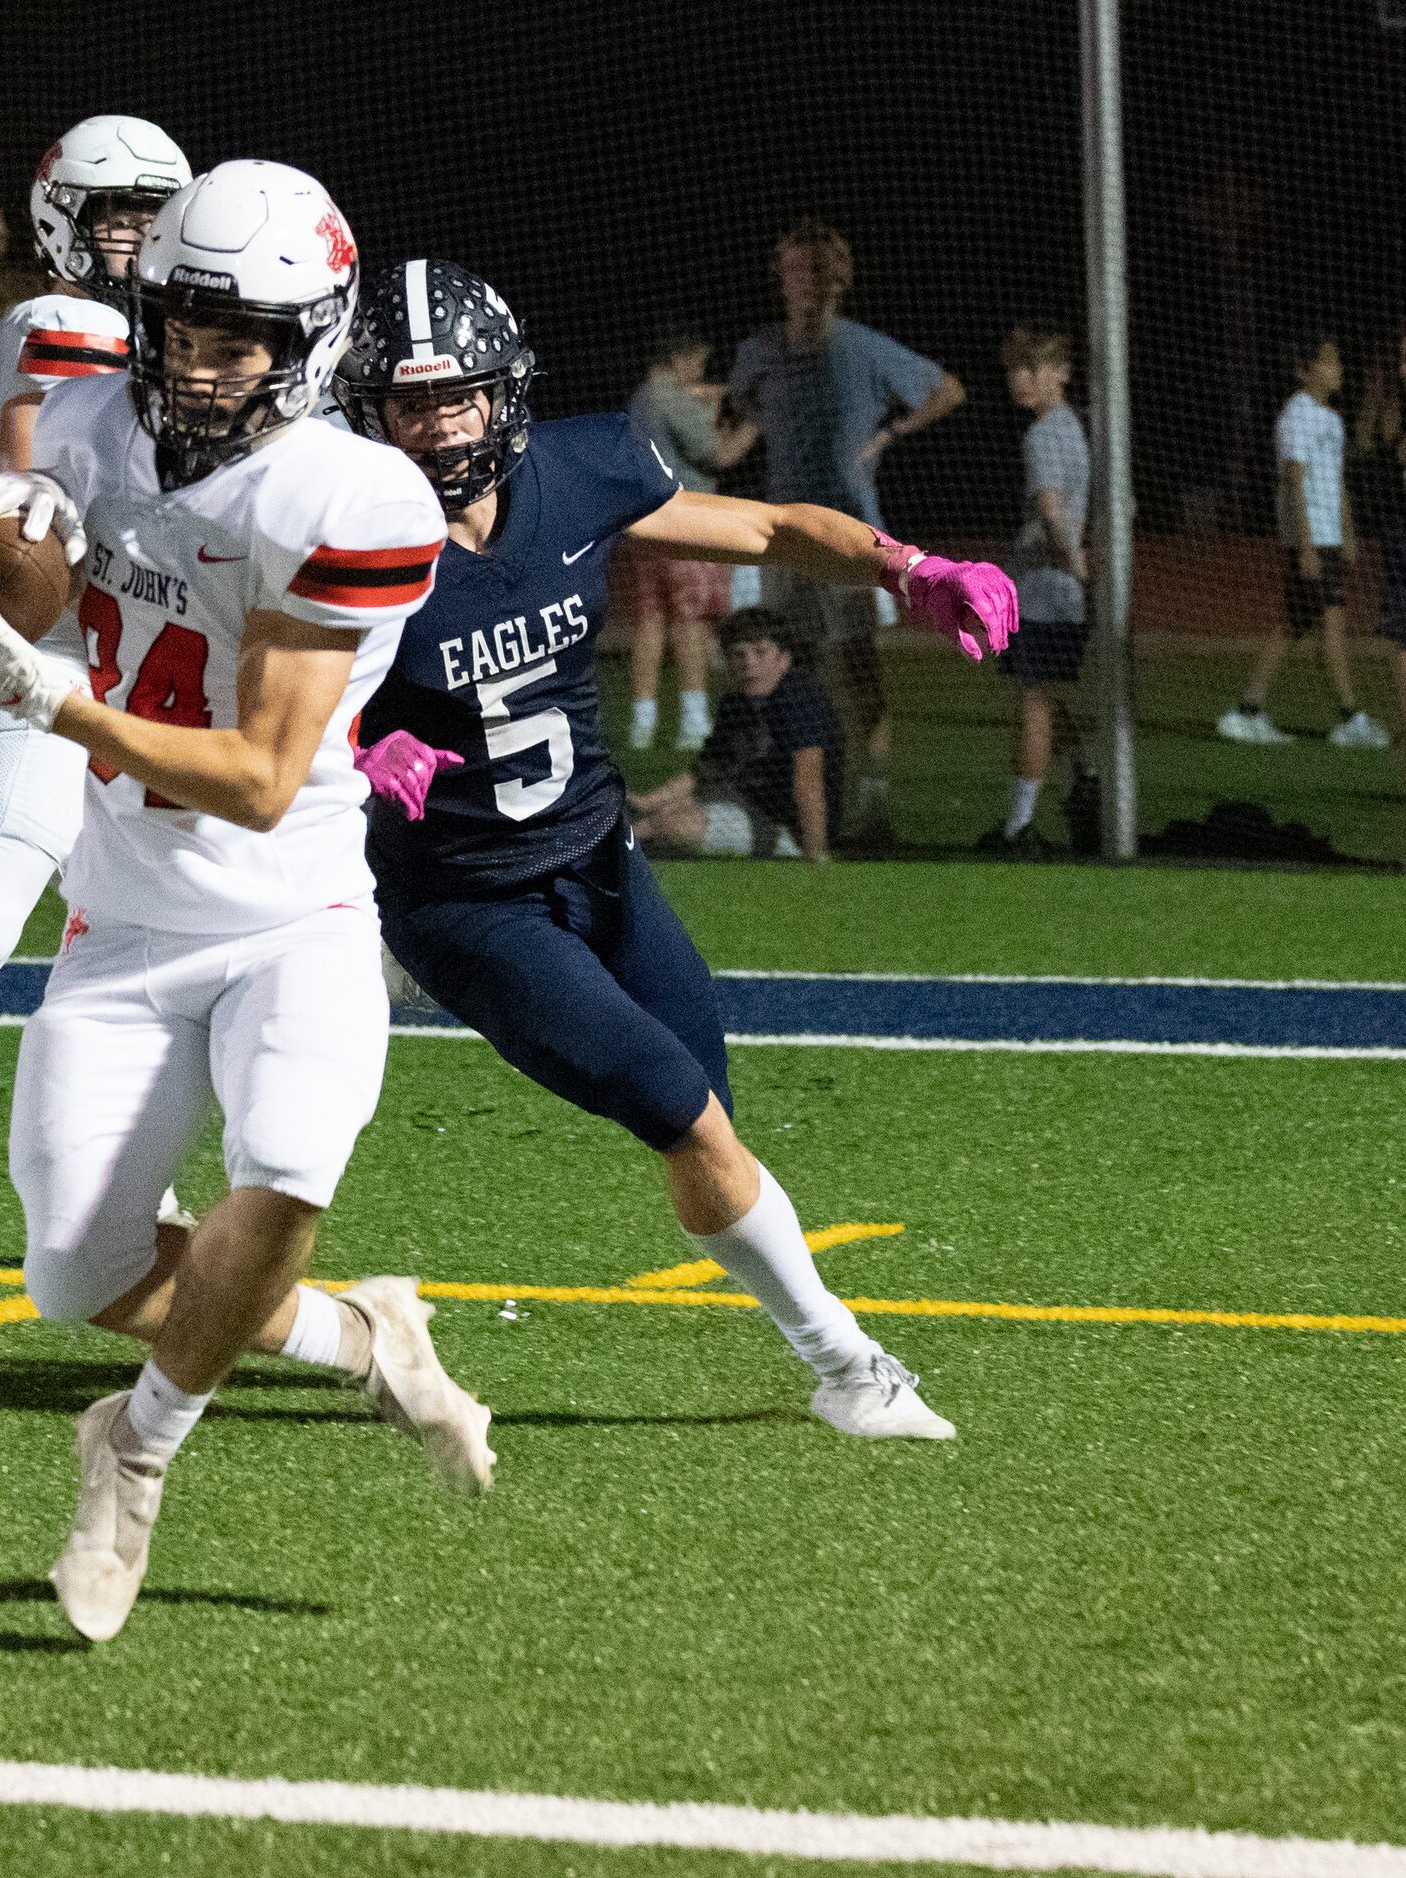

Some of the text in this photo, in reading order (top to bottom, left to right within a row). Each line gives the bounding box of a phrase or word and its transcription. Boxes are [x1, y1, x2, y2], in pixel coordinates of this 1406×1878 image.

[174, 267, 232, 291] Riddell
[400, 359, 451, 376] Riddell
[92, 542, 188, 616] ST. JOHN'S
[439, 594, 588, 691] EAGLES
[475, 658, 575, 822] 5
